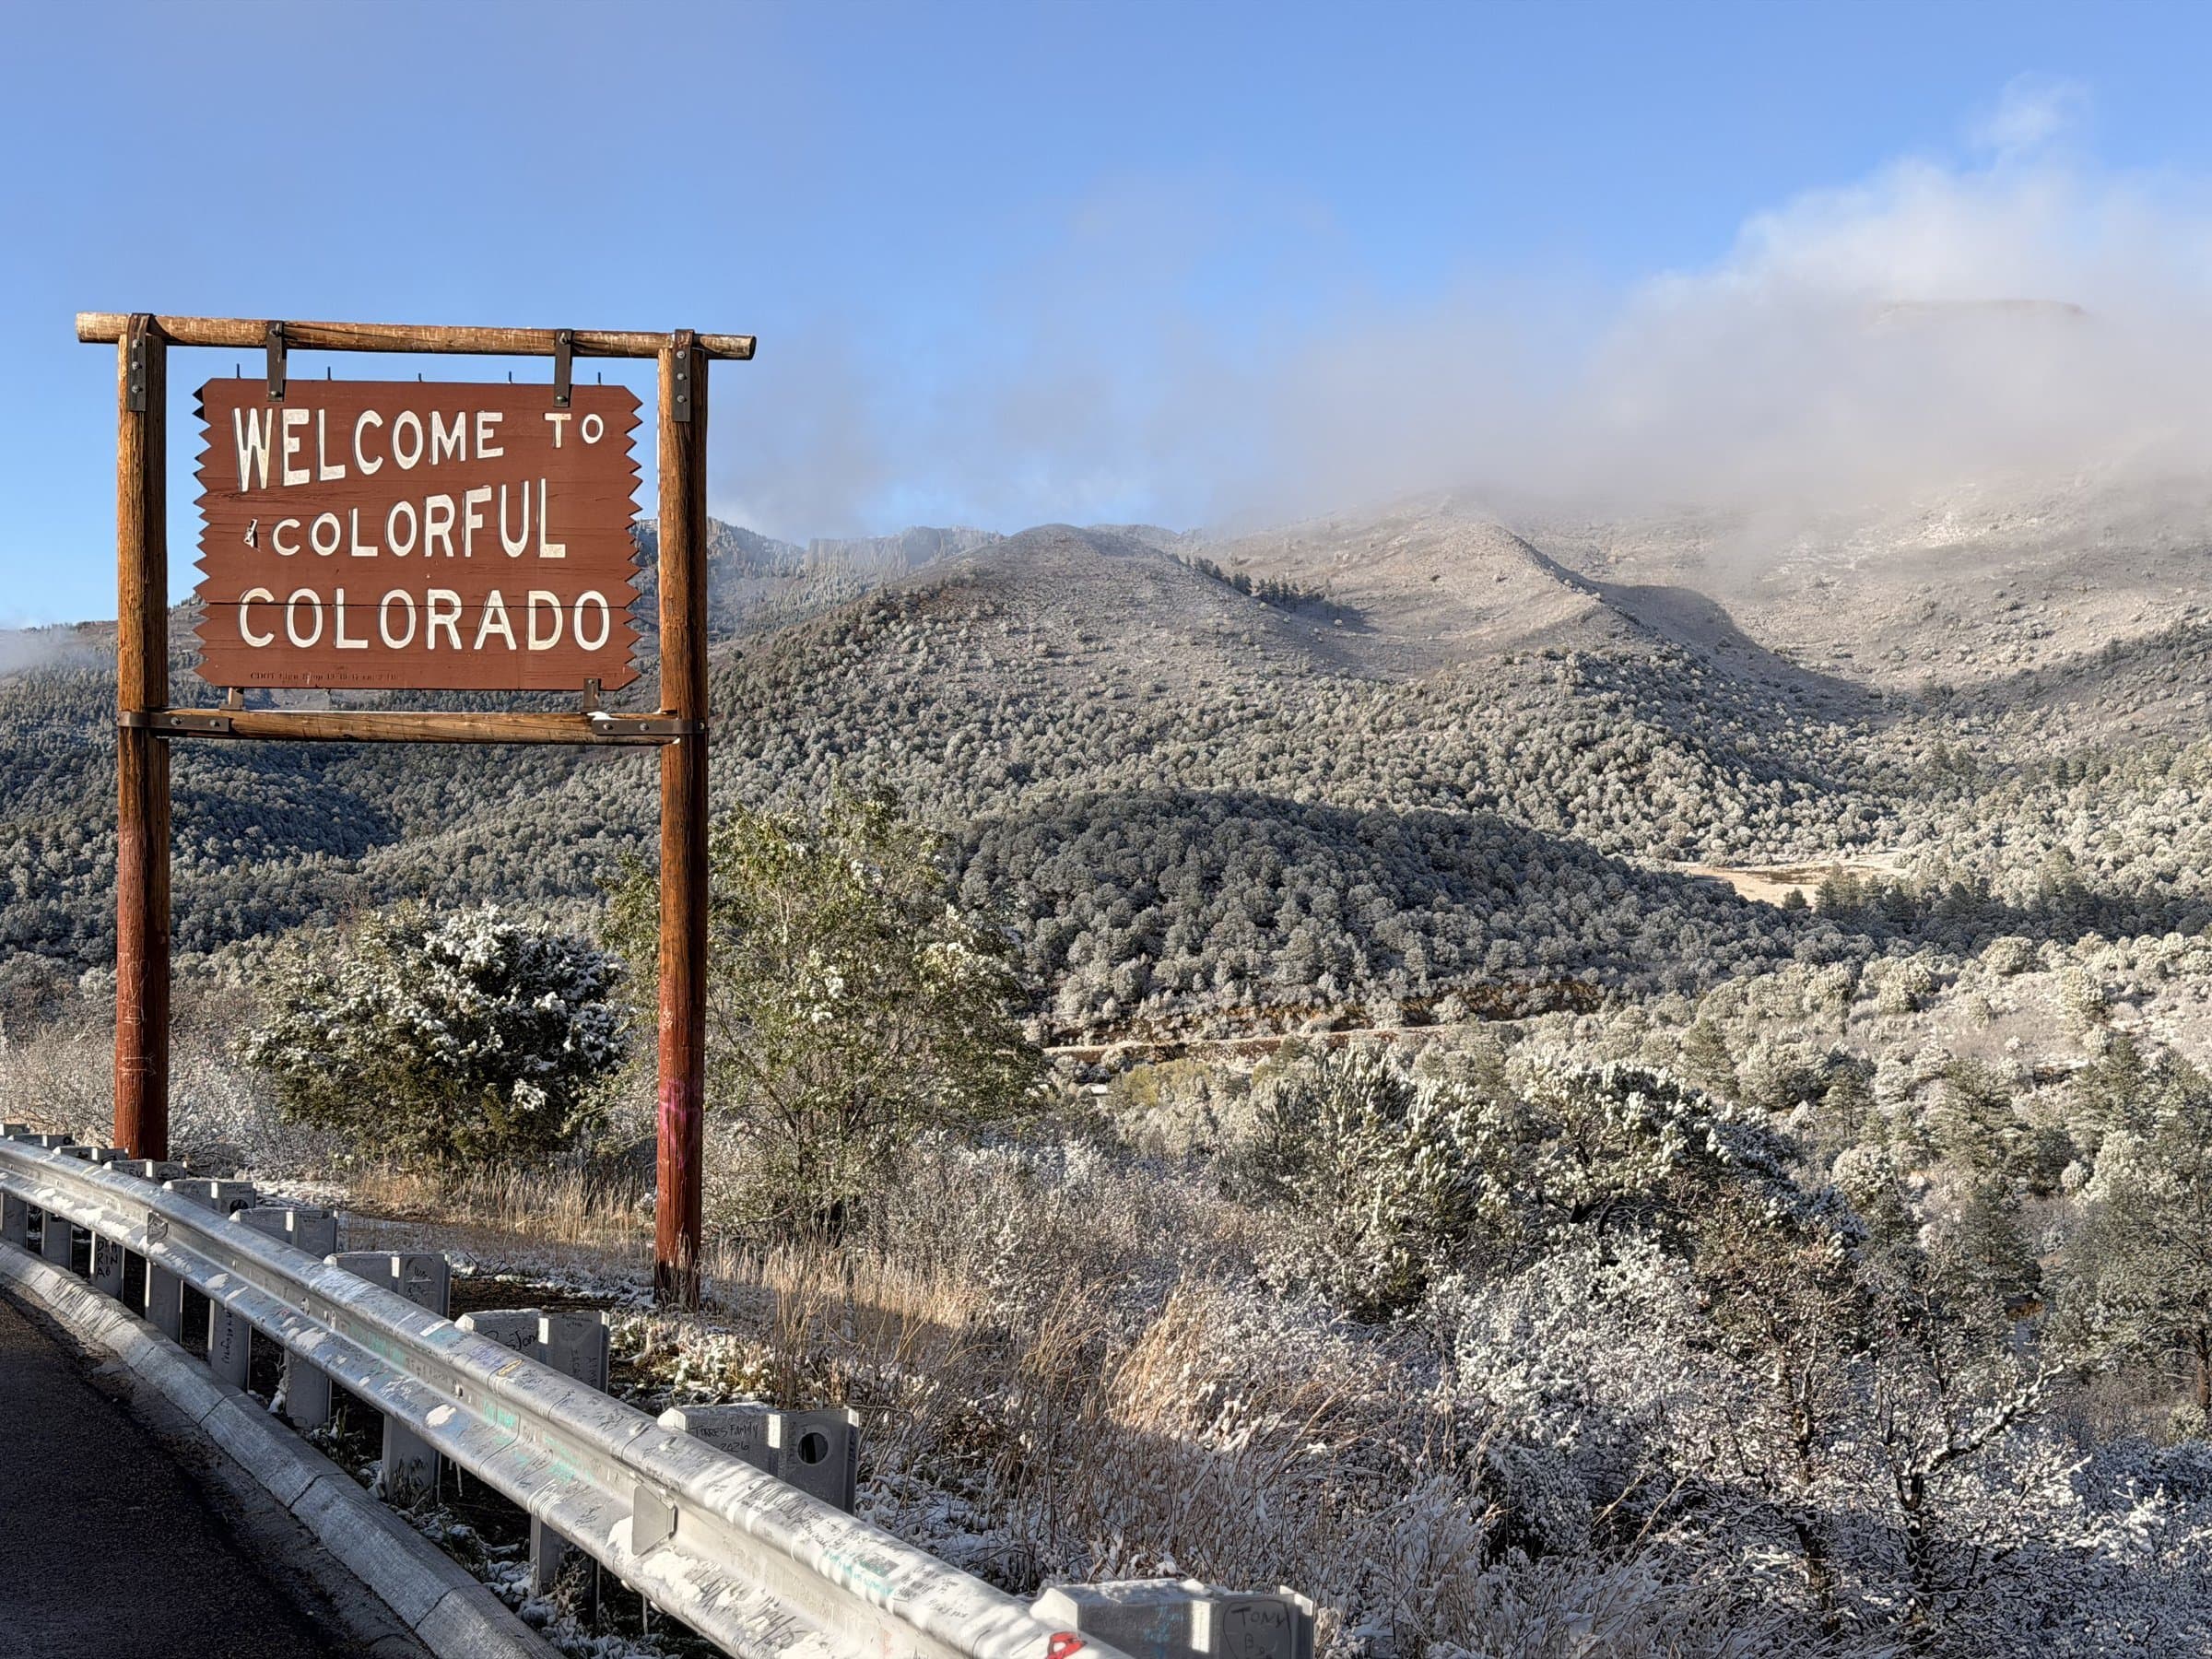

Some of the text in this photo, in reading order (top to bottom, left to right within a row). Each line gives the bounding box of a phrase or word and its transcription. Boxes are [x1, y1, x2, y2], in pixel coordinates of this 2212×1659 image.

[231, 407, 604, 492] WELCOME TO
[272, 478, 566, 559] COLORFUL
[238, 587, 611, 652] COLORADO
